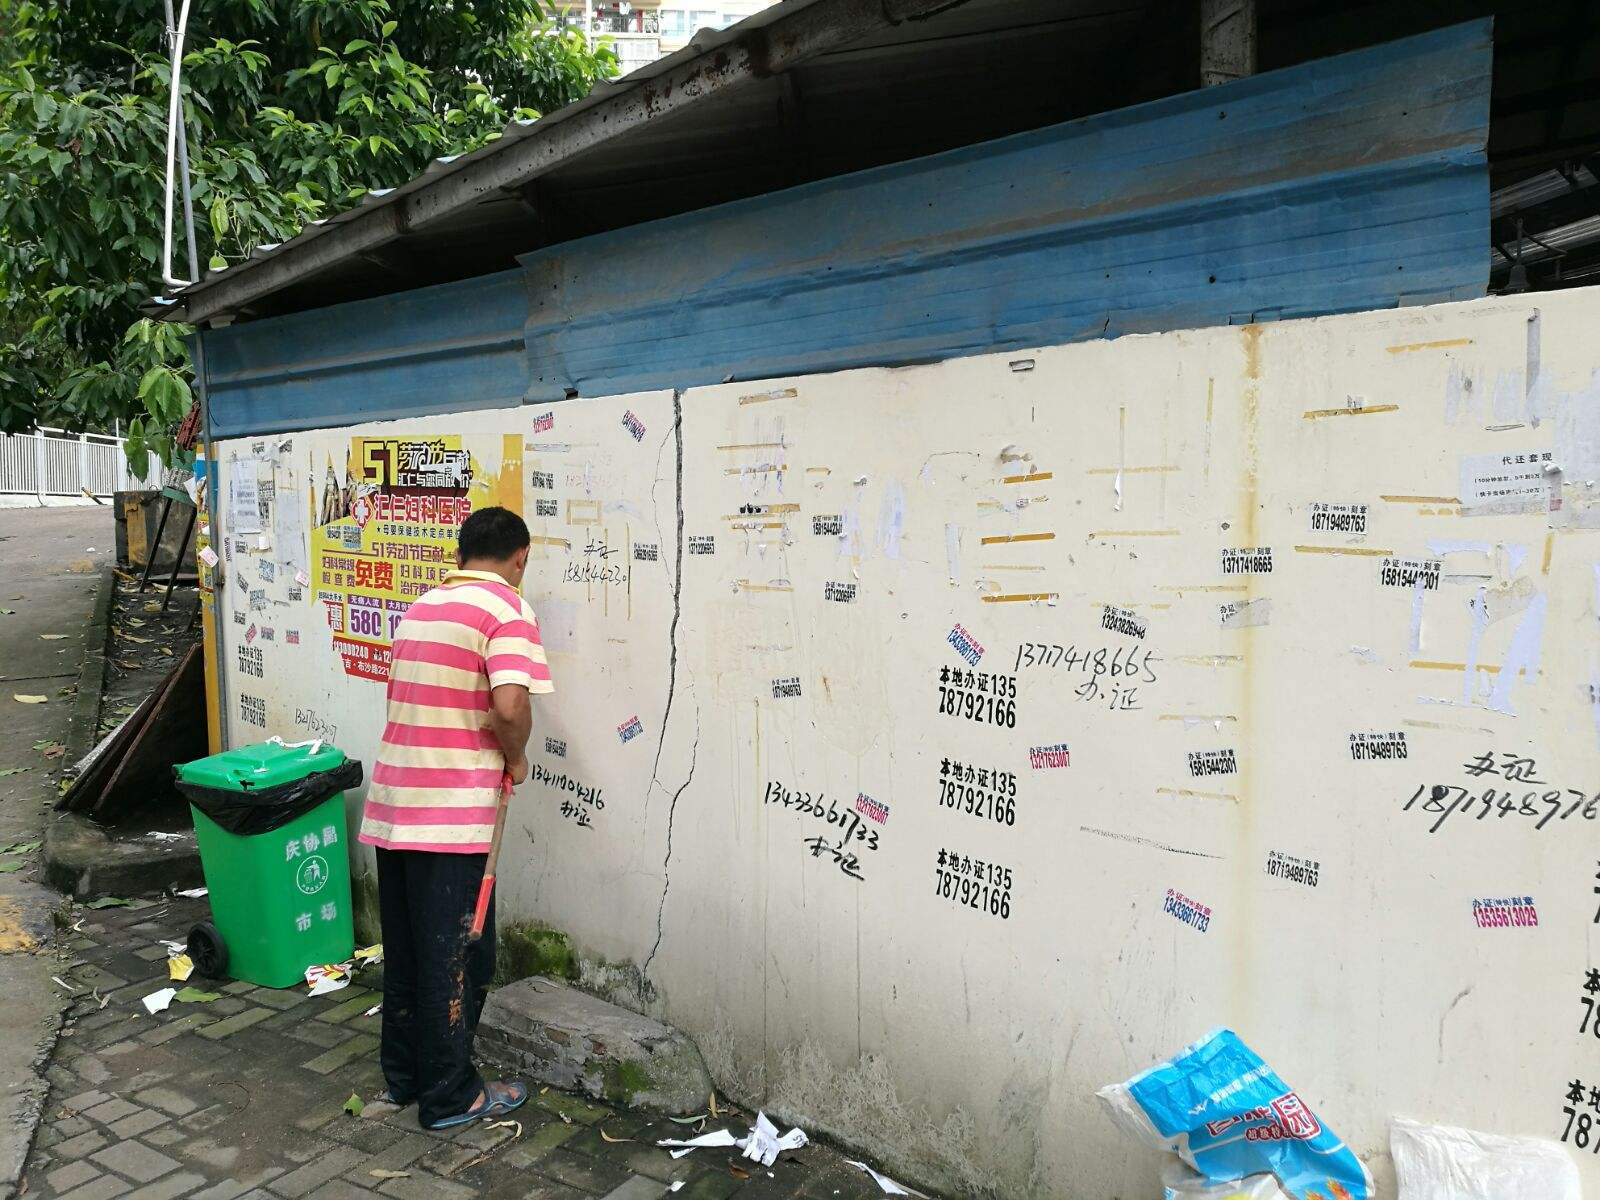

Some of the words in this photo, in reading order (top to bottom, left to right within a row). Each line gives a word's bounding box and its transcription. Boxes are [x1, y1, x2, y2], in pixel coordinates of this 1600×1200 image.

[363, 441, 398, 486] 51
[1502, 453, 1552, 465] 代还套现
[374, 494, 472, 526] 汇仁妇科医院
[1311, 513, 1366, 532] 18719489763
[372, 542, 444, 563] 51劳动节巨献
[1222, 556, 1272, 573] 13717418665
[322, 572, 355, 587] 检查费
[355, 559, 393, 591] 免费
[350, 608, 382, 637] 580
[939, 665, 1017, 699] 本地办证135
[938, 686, 1016, 729] 78792166
[1190, 757, 1237, 776] 15815442301
[1351, 741, 1408, 760] 18719489763
[939, 757, 1017, 797] 本地办证135
[764, 781, 879, 850] 13433661733
[939, 779, 1016, 827] 78792166
[937, 848, 1012, 890] 本地办证135
[936, 868, 1011, 919] 78792166
[1163, 896, 1210, 932] 13433661733
[1473, 906, 1539, 927] 13535613029
